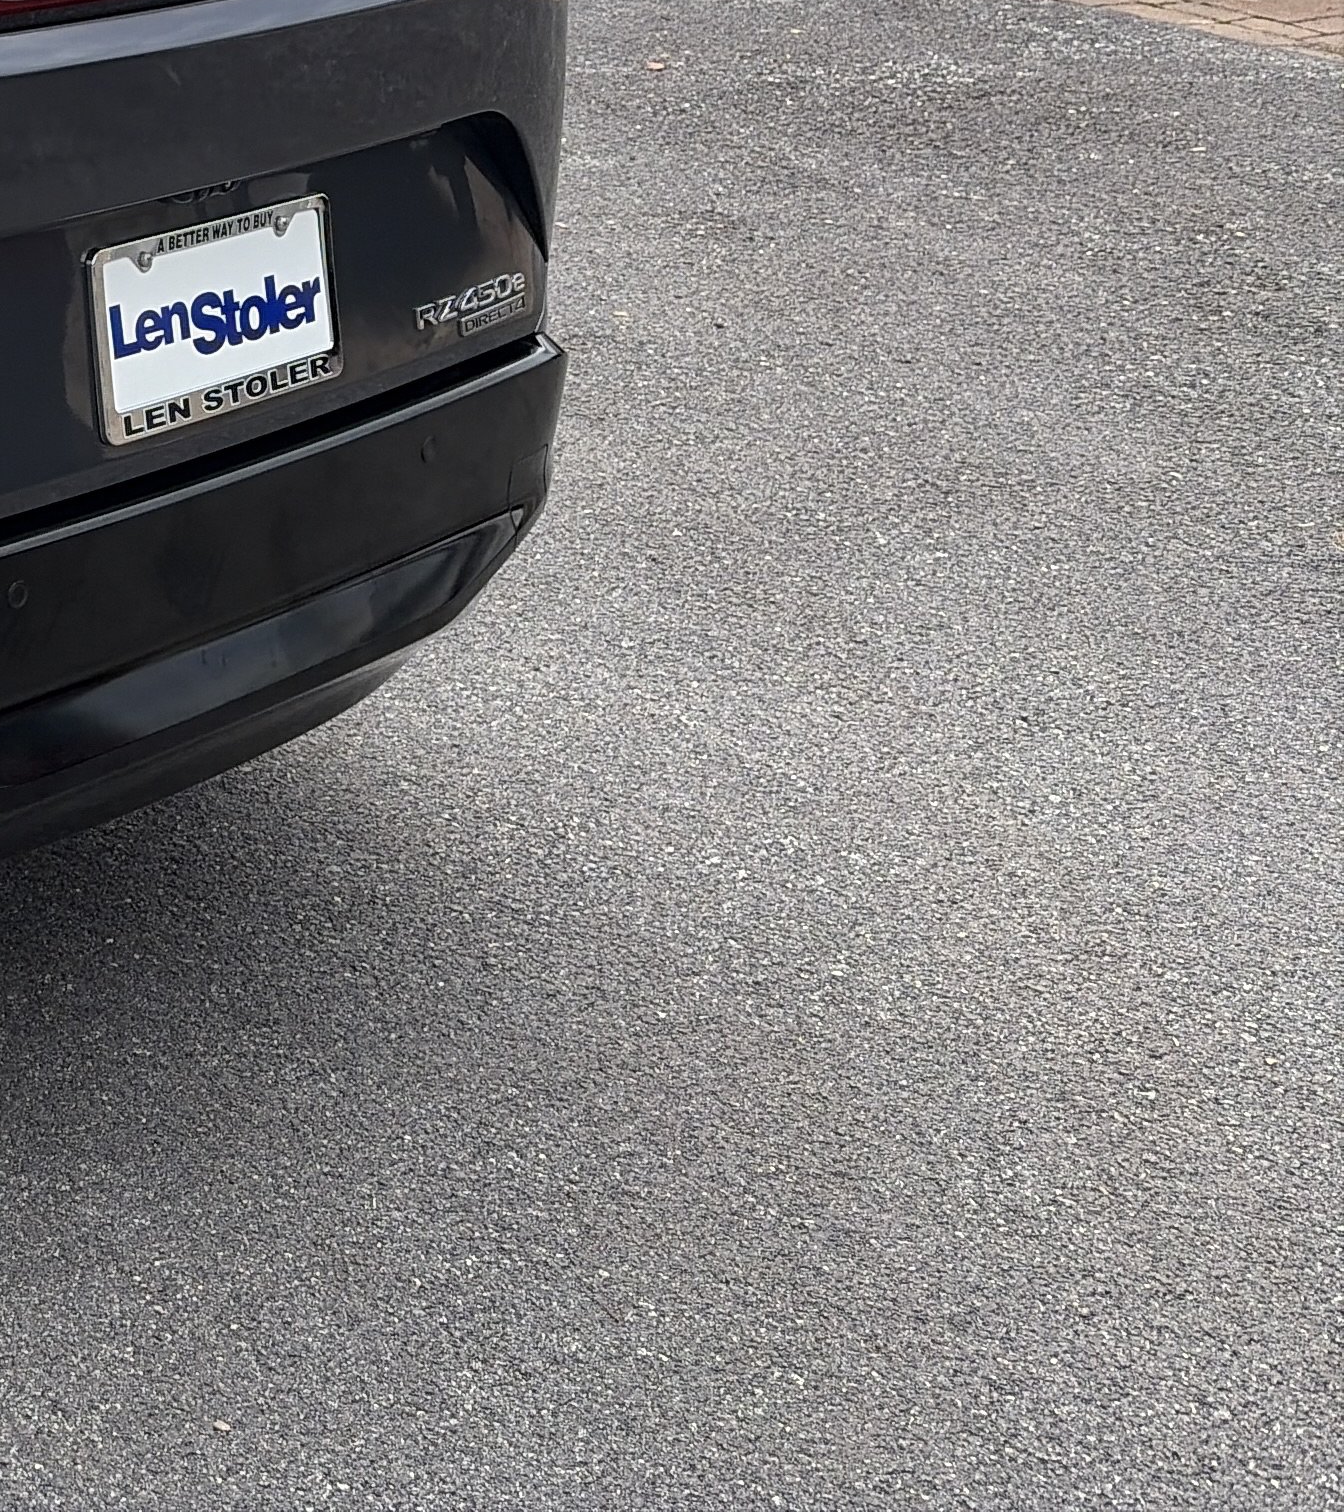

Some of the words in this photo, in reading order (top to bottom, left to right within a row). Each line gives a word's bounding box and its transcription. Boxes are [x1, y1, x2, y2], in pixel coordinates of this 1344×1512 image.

[157, 238, 165, 254] A
[168, 226, 210, 251] BETTER
[212, 221, 234, 240] WAY
[236, 216, 251, 234] TO
[252, 210, 274, 229] BUY
[123, 396, 192, 438] LEN
[202, 354, 333, 413] STOLER
